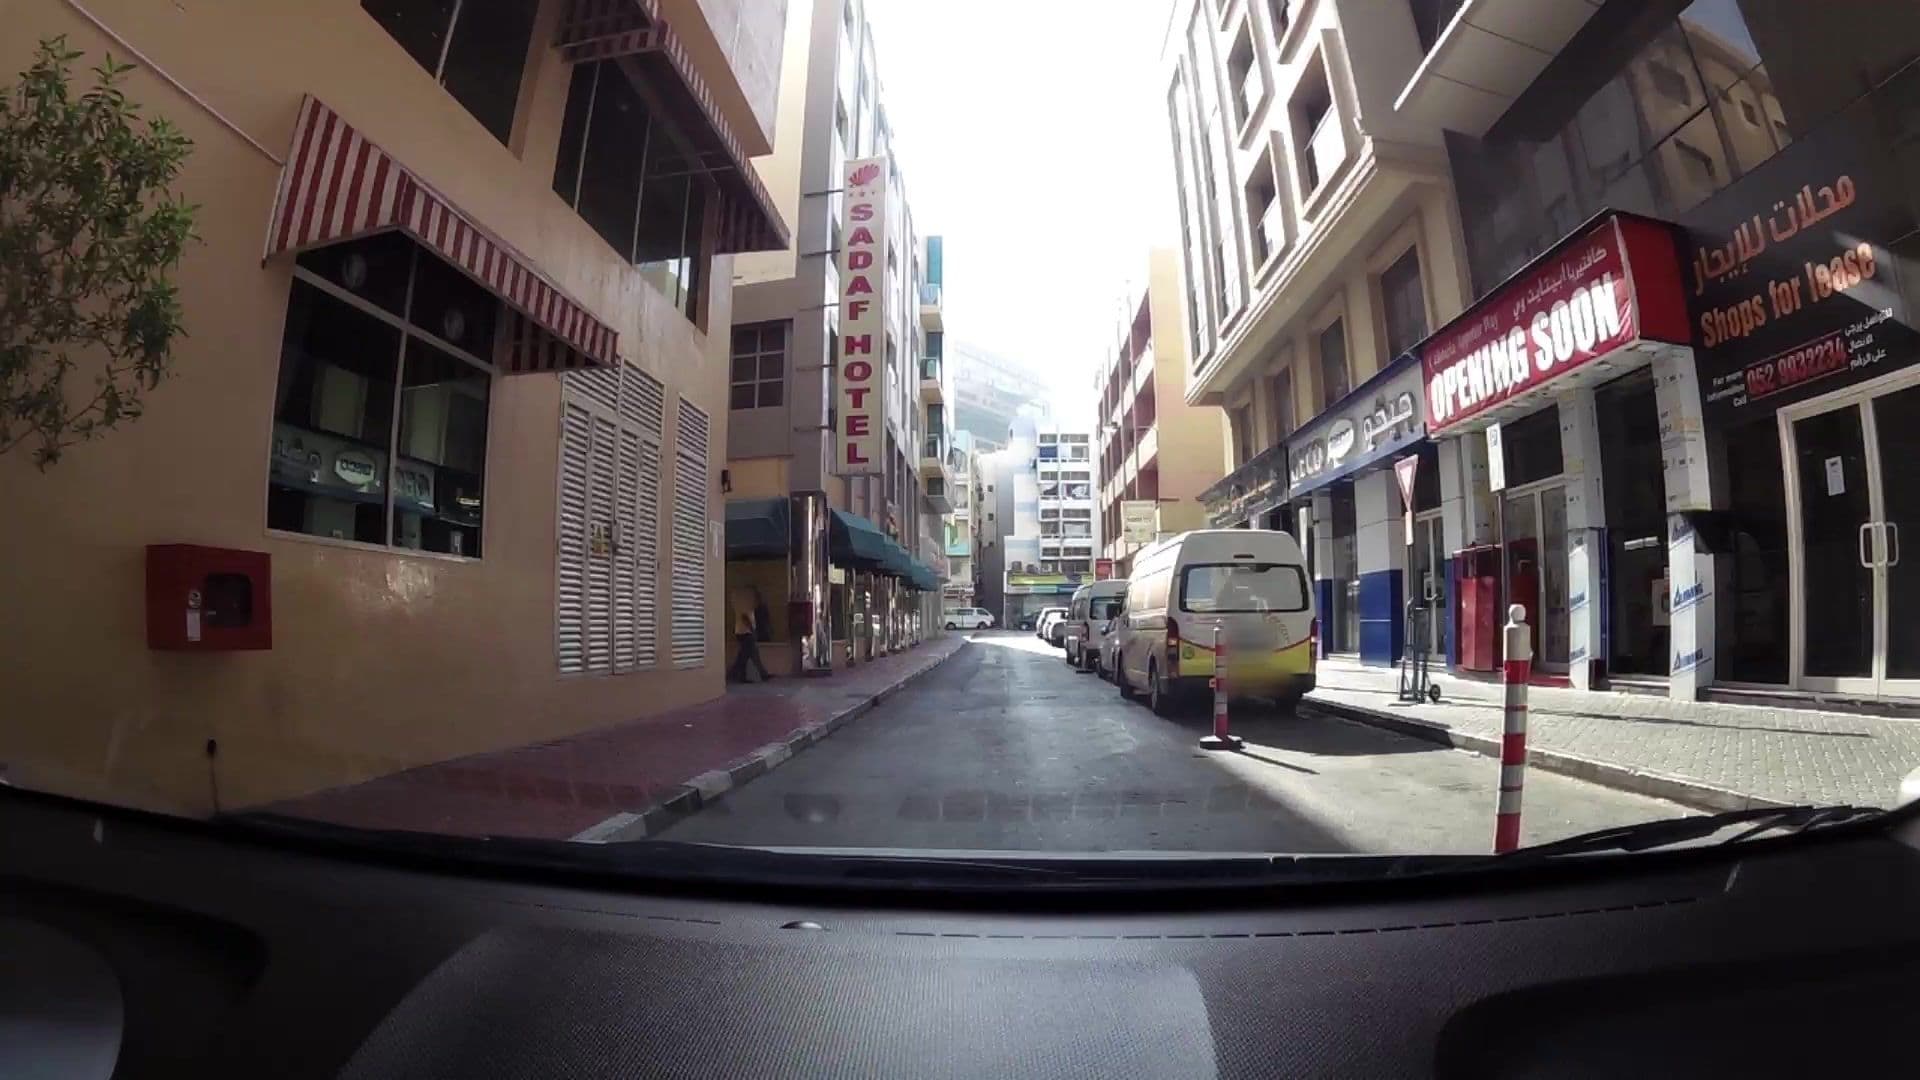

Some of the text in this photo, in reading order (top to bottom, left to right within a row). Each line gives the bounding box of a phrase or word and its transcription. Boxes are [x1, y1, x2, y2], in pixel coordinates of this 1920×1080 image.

[1769, 176, 1856, 242] محلات
[843, 203, 874, 464] SADAF HOTEL
[1430, 272, 1620, 421] OPENING SOON
[1701, 243, 1876, 347] Shops for lease
[1747, 363, 1775, 395] 052
